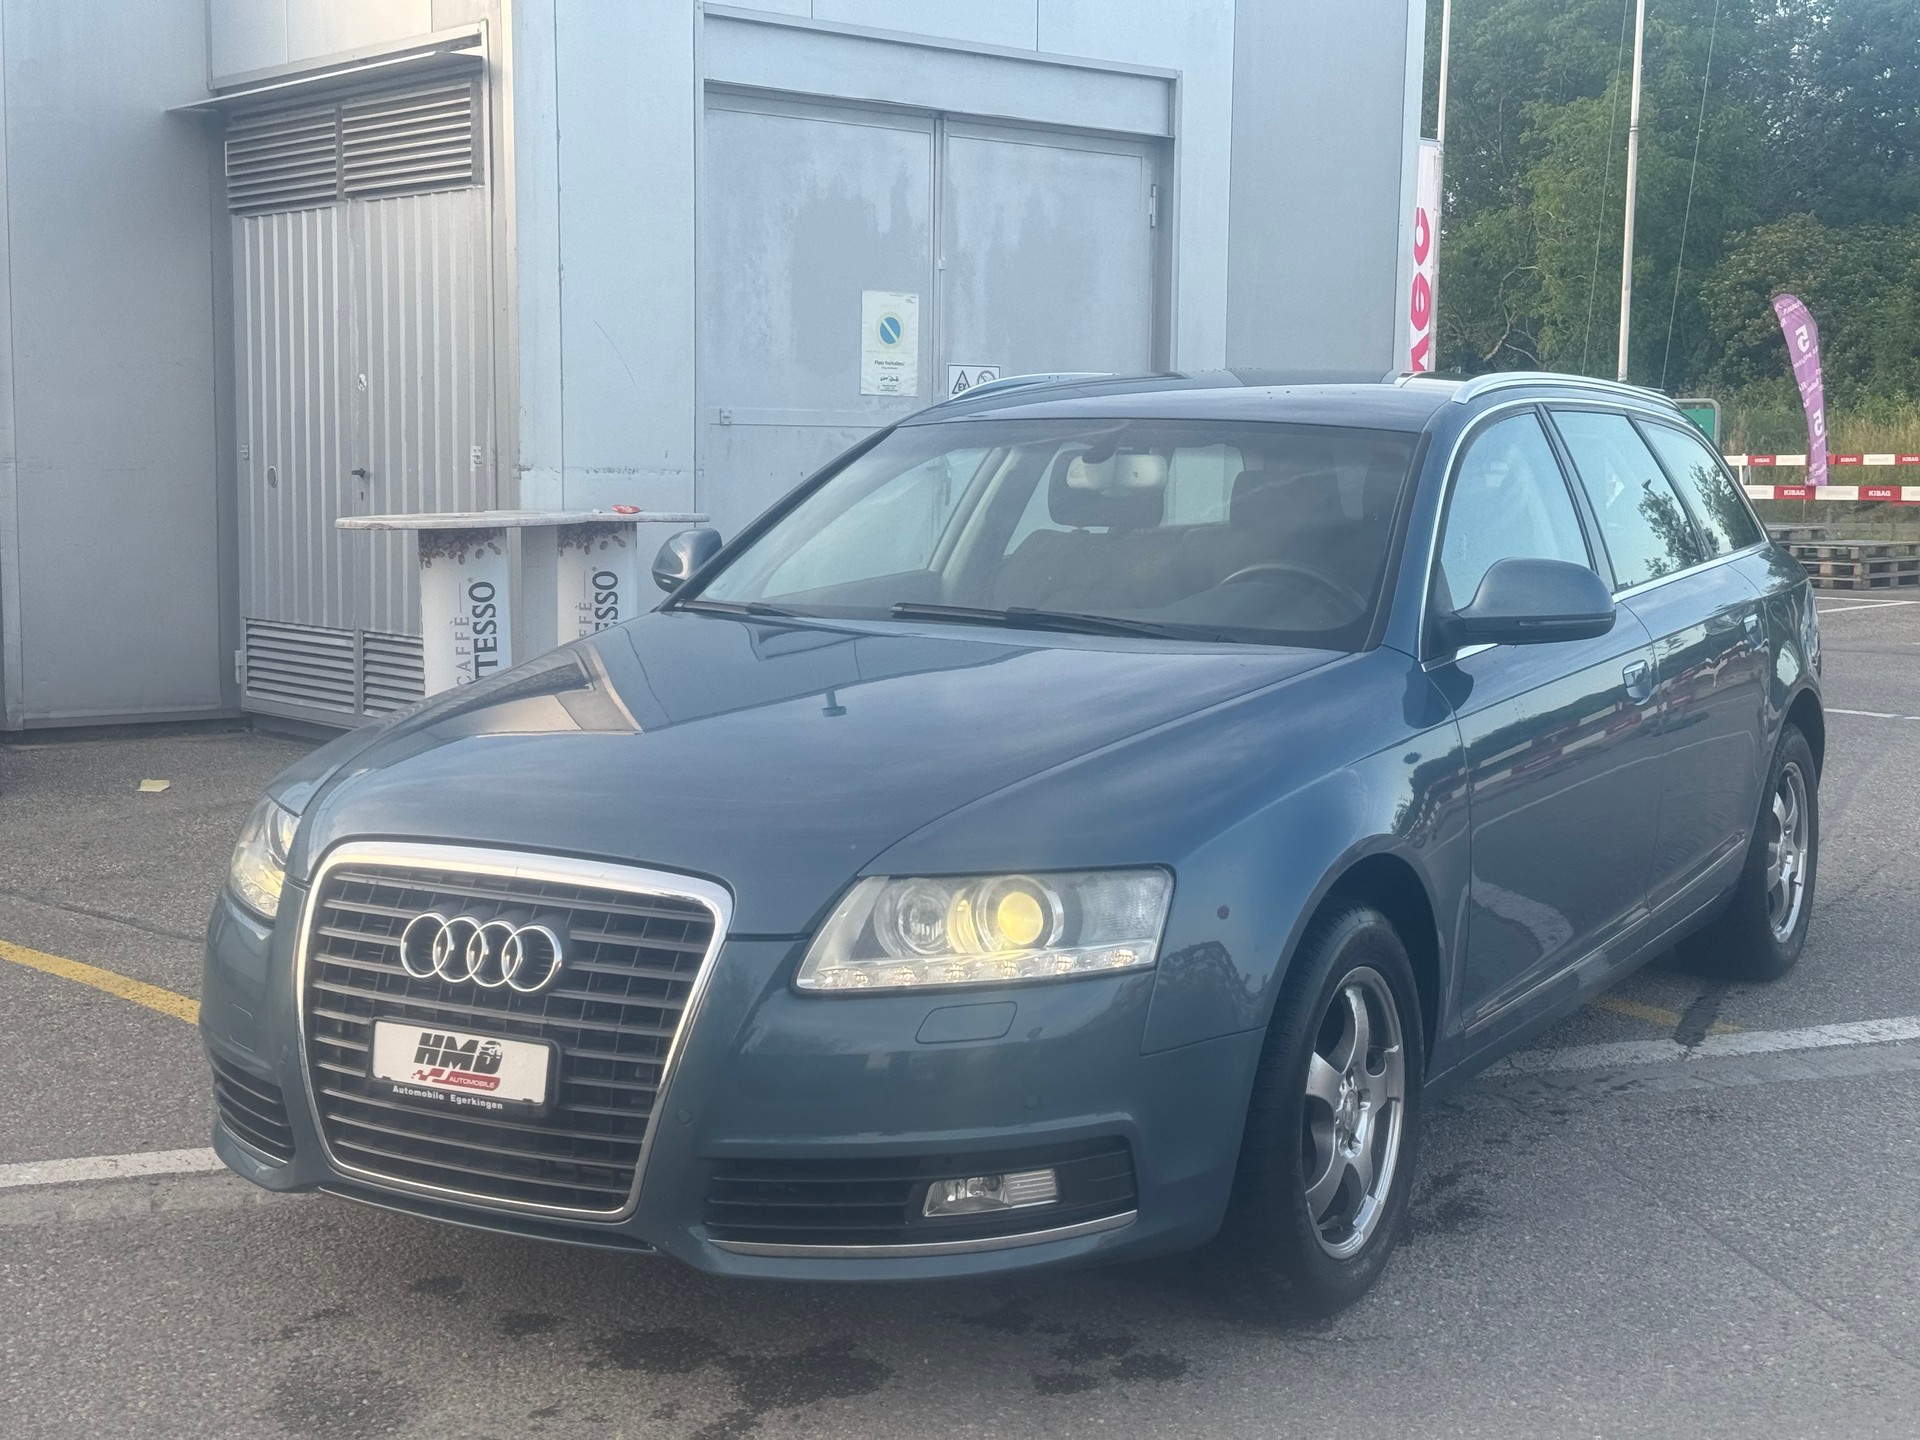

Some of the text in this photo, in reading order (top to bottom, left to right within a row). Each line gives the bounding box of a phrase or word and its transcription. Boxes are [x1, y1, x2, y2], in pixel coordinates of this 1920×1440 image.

[450, 616, 472, 686] CAFFÈ
[467, 581, 498, 680] TESSO
[392, 1085, 504, 1110] Automobile Egerkingen
[448, 1076, 496, 1088] AUTOMOBILE
